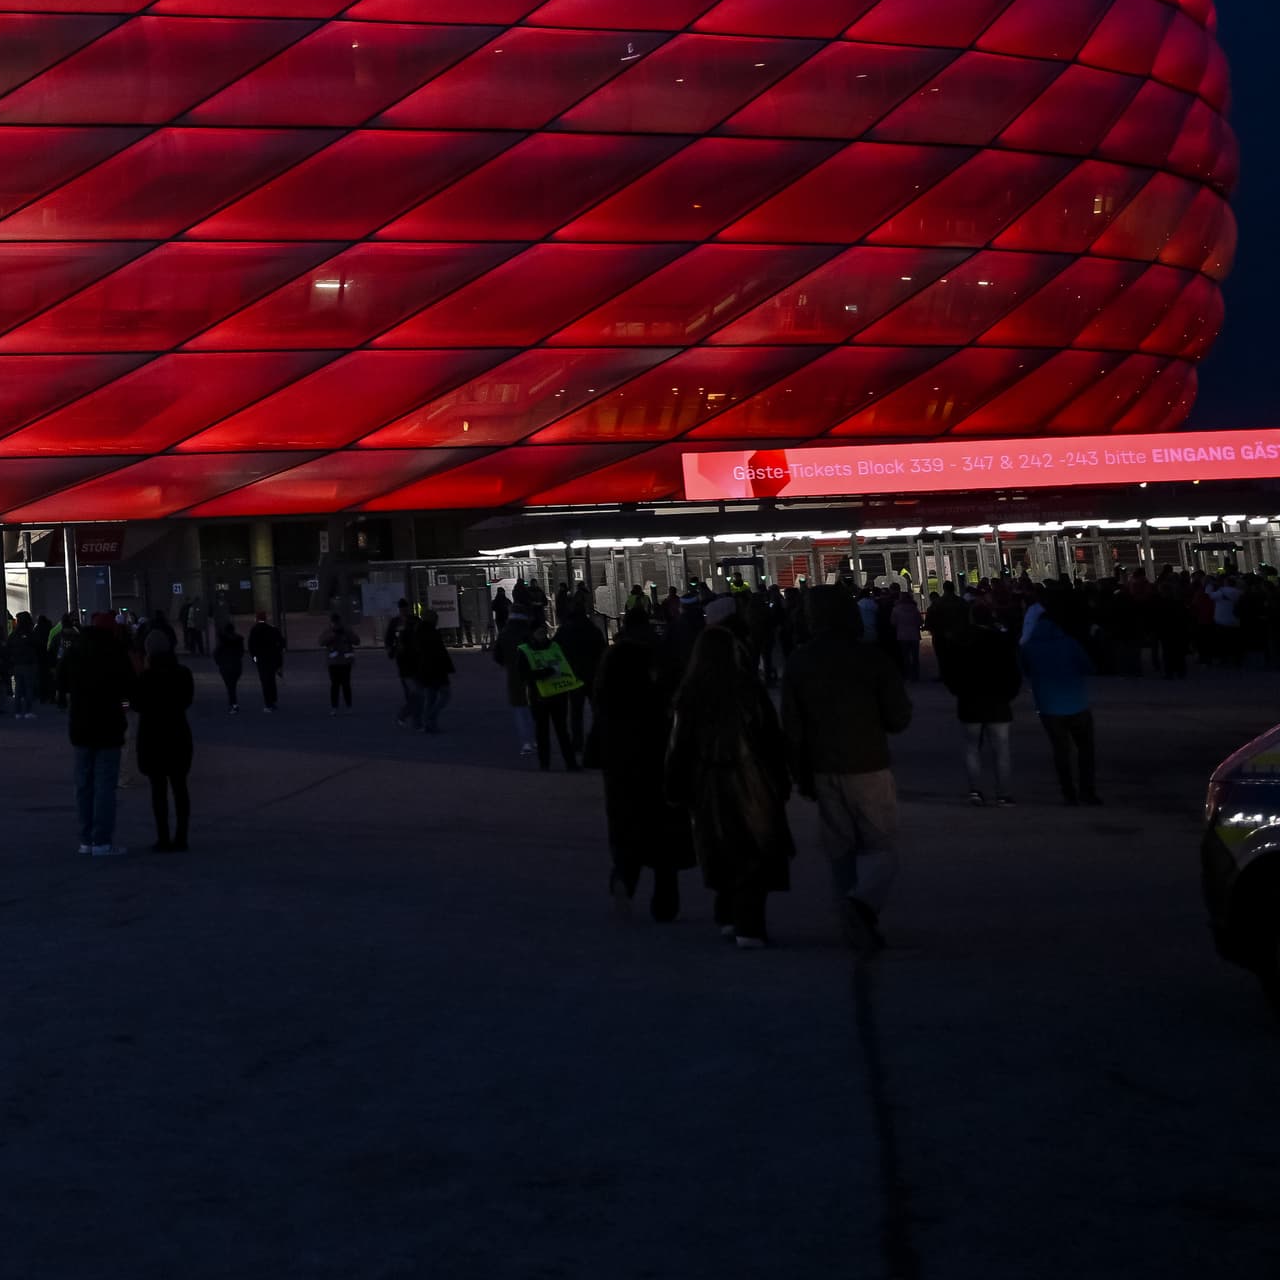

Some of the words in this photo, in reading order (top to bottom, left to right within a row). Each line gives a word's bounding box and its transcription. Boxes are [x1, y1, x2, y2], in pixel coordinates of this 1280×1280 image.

[732, 461, 853, 481] Gäste-Tickets
[857, 458, 905, 476] Block
[909, 457, 945, 474] 339
[961, 456, 994, 472] 347
[999, 455, 1014, 470] &
[1018, 453, 1055, 469] 242
[1058, 450, 1099, 466] -243
[1104, 449, 1147, 465] bitte
[1151, 445, 1236, 463] EINGANG
[1240, 440, 1280, 460] GÄS
[80, 541, 120, 553] STORE
